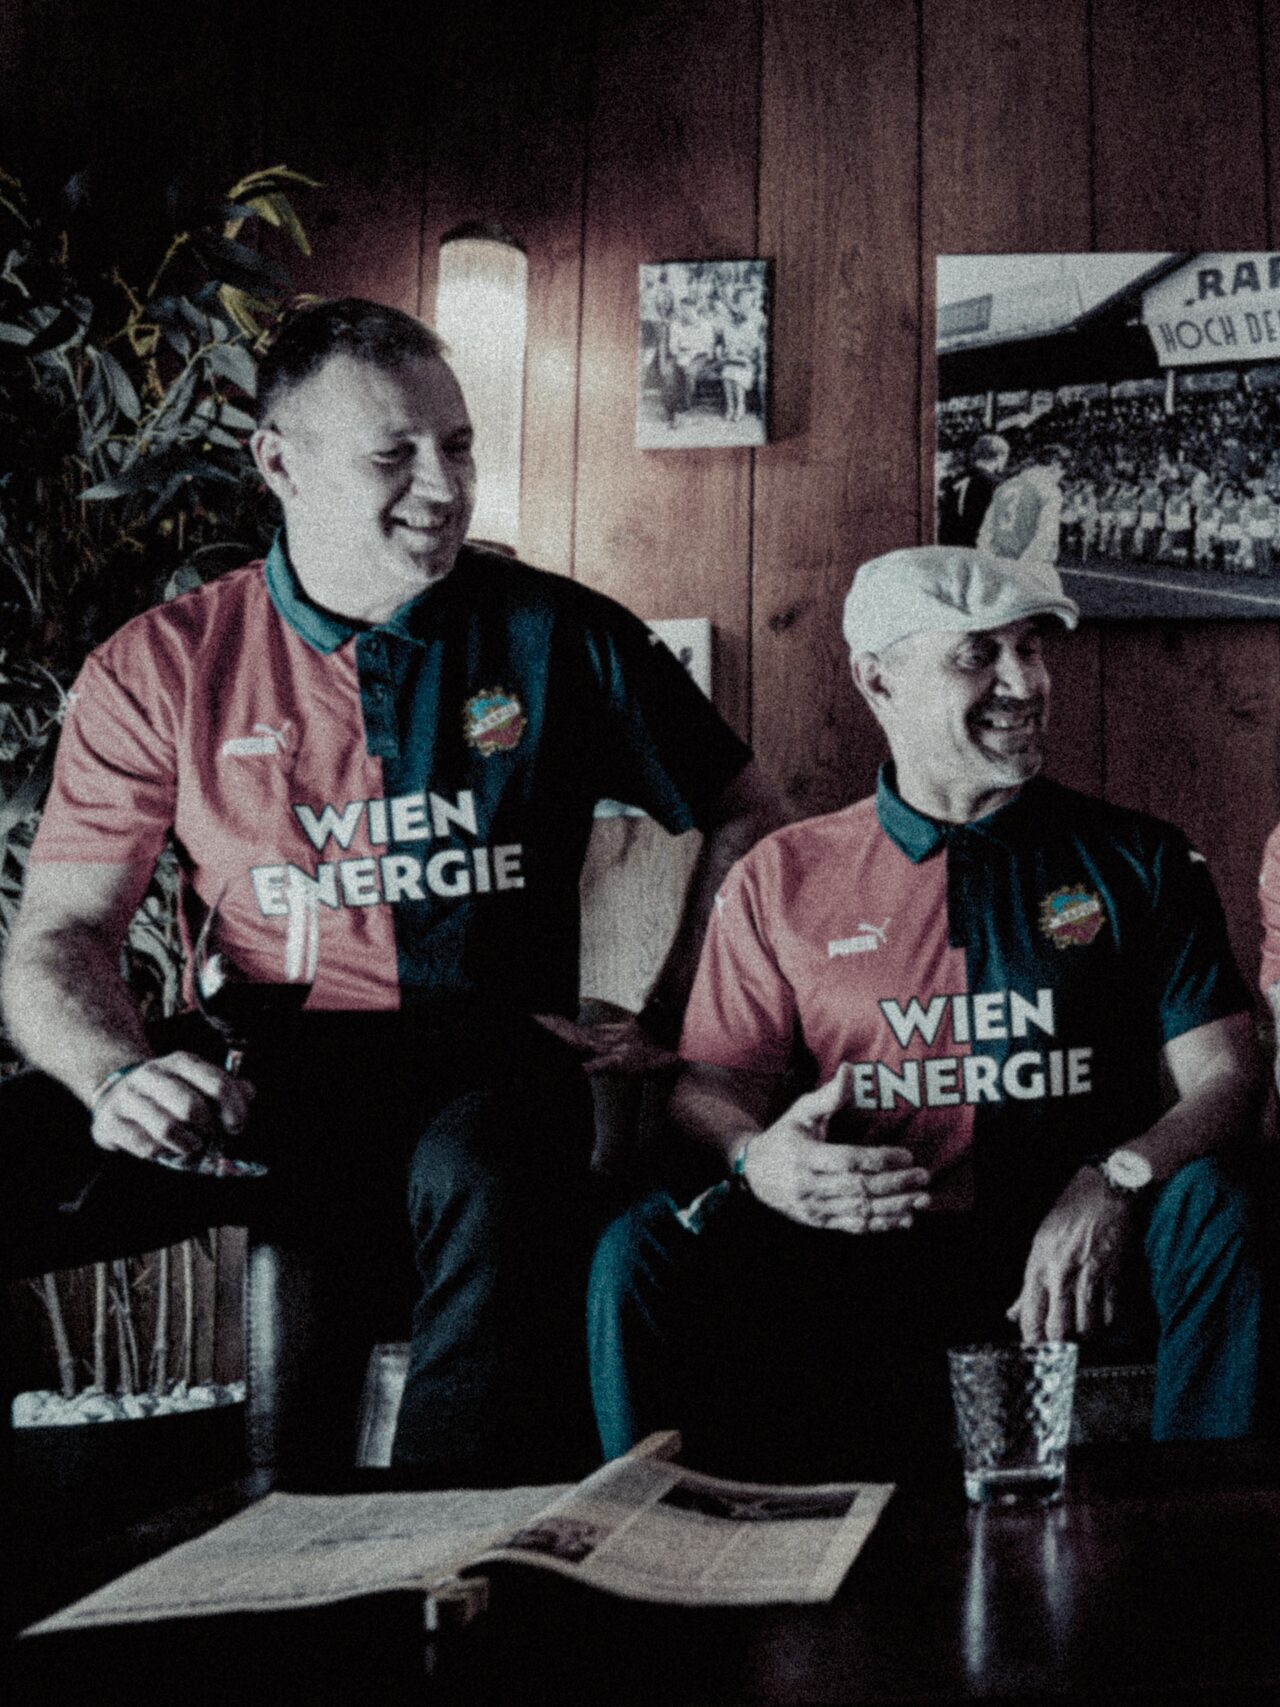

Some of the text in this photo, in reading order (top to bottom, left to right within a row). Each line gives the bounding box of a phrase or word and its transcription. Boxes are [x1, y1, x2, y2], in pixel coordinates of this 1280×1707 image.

[1158, 313, 1237, 351] HOCH
[294, 789, 479, 850] WIEN
[251, 844, 526, 917] ENERGIE
[879, 988, 1055, 1049] WIEN
[852, 1046, 1094, 1110] ENERGIE
